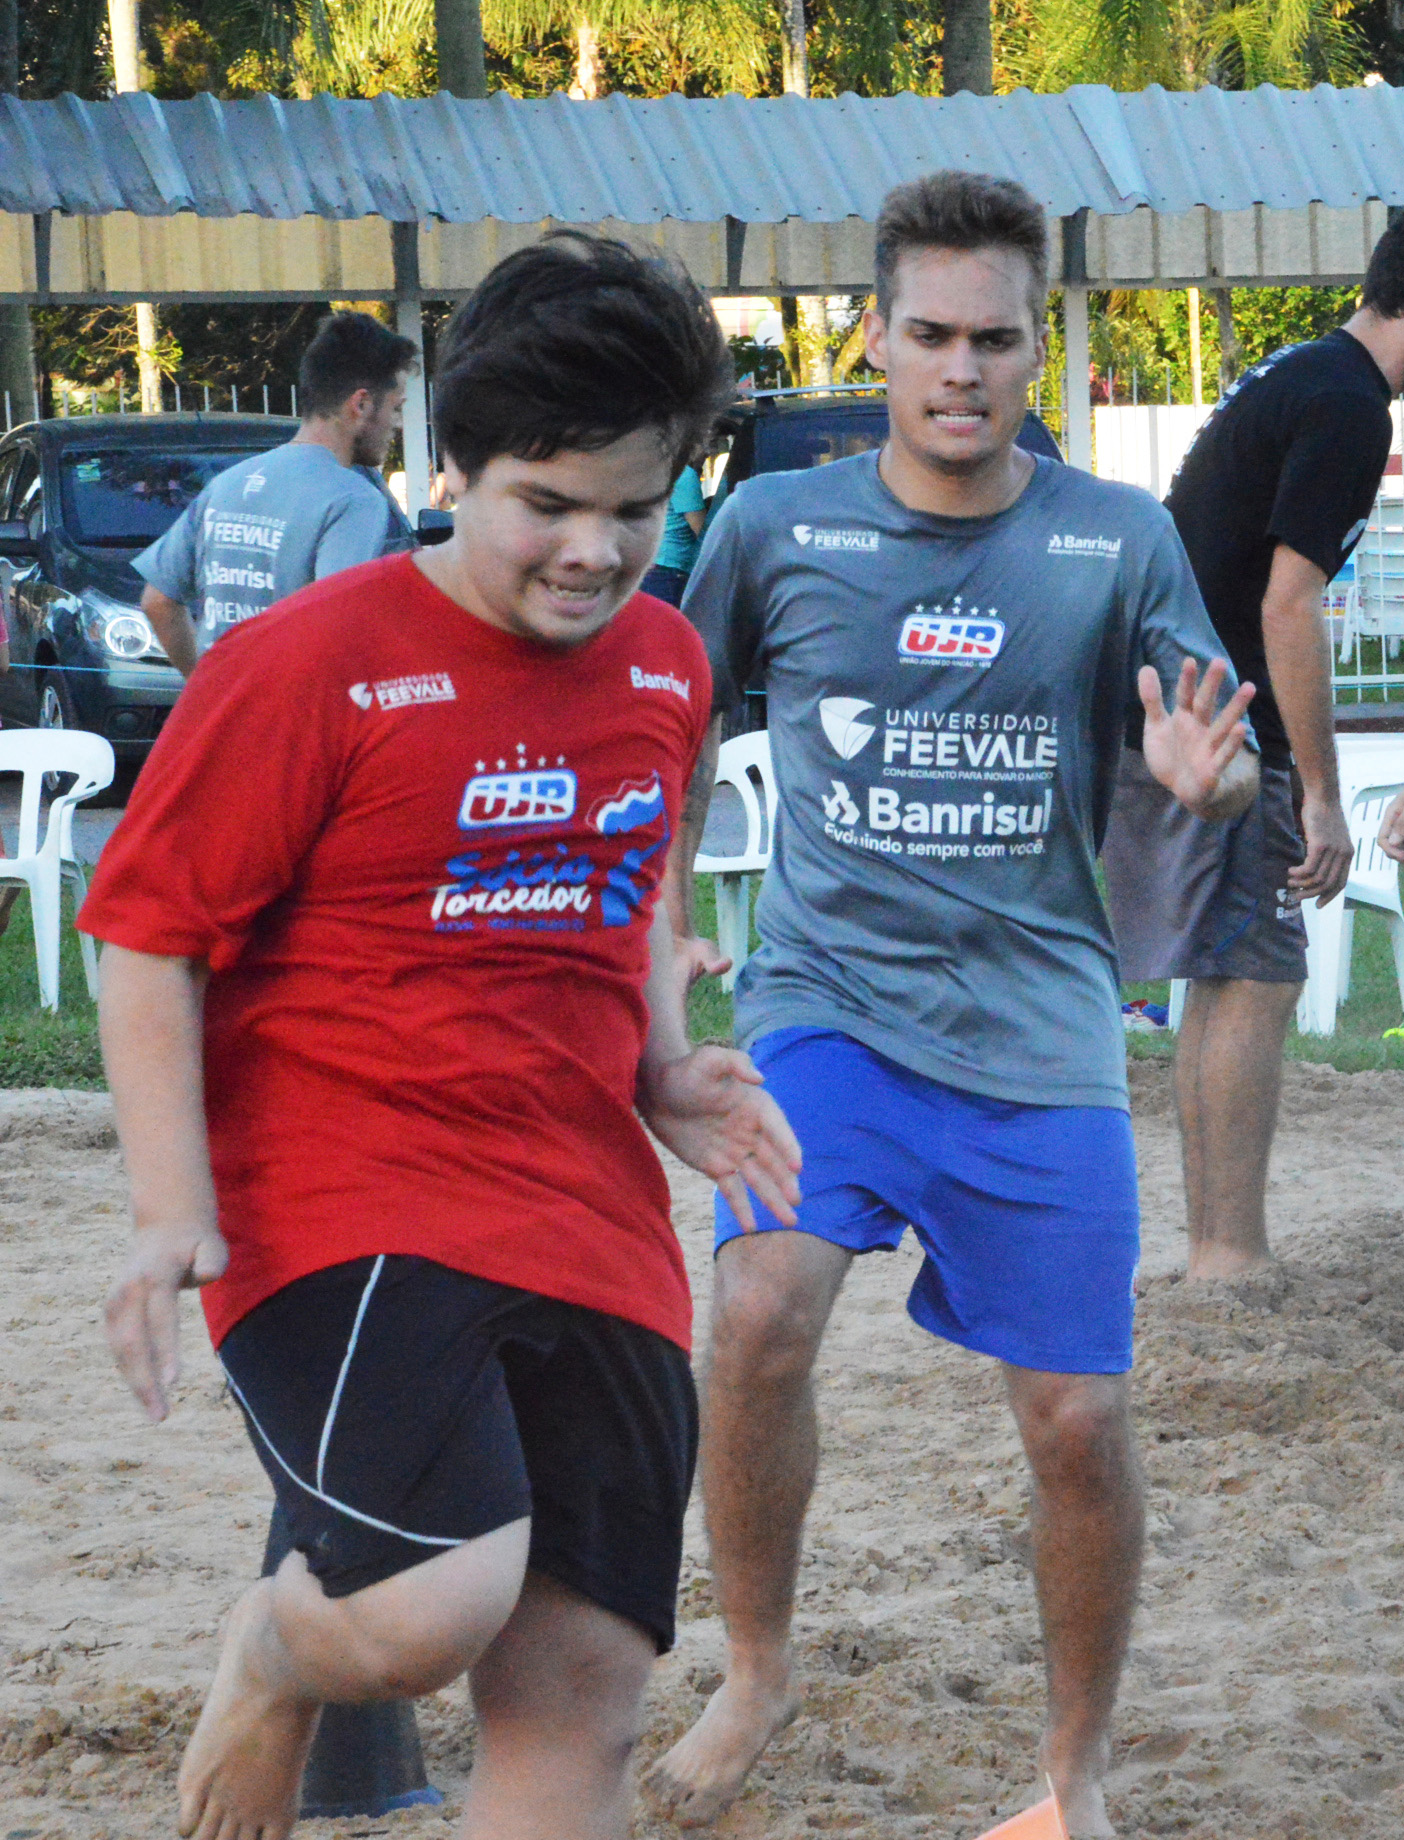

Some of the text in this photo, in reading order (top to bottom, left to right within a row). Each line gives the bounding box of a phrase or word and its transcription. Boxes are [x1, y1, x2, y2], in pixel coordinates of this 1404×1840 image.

[214, 521, 284, 550] FEEVALE
[814, 535, 880, 548] FEEVALE
[1064, 535, 1122, 552] Banrisul
[907, 622, 997, 654] UJR
[376, 680, 455, 706] FEEVALE
[630, 665, 691, 700] Banrisul
[886, 709, 1057, 734] UNIVERSIDADE
[884, 729, 1058, 768] FEEVALE
[883, 767, 956, 780] CONHECIMENTO
[958, 770, 982, 780] PARA
[983, 771, 1016, 781] INOVAR
[467, 779, 568, 821] UJR
[869, 787, 1053, 836] Banrisul
[907, 842, 969, 861] sempre
[973, 844, 1005, 857] com
[430, 880, 592, 921] Torcedor
